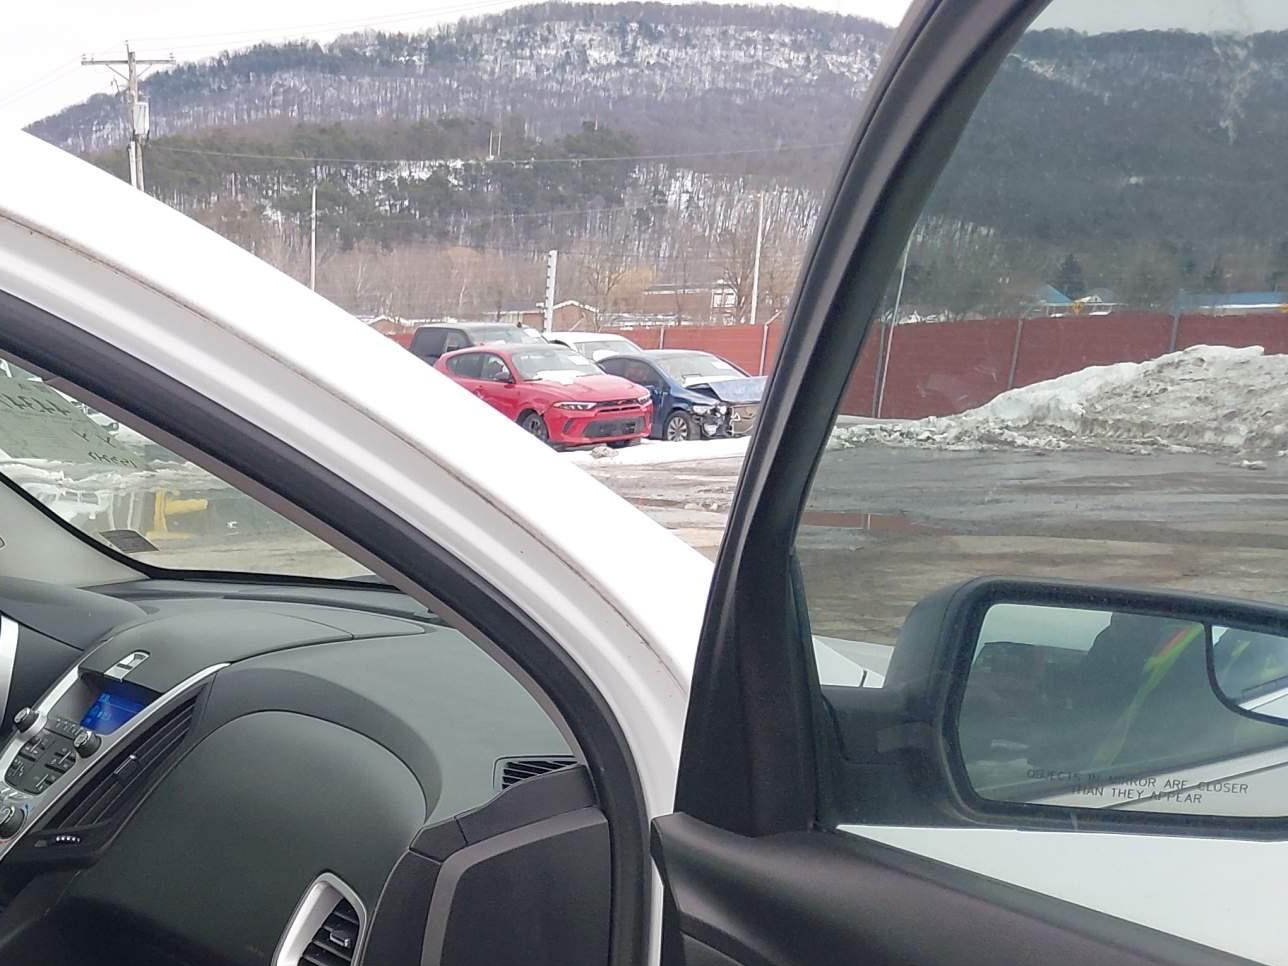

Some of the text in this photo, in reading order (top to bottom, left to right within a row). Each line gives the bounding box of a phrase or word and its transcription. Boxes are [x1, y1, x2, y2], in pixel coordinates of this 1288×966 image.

[1026, 768, 1081, 783] OBJECTS
[1109, 774, 1157, 788] MIRROR
[1164, 779, 1188, 791] ARE
[1198, 781, 1249, 794] CLOSER
[1073, 783, 1203, 804] THAN THEY APPEAR
